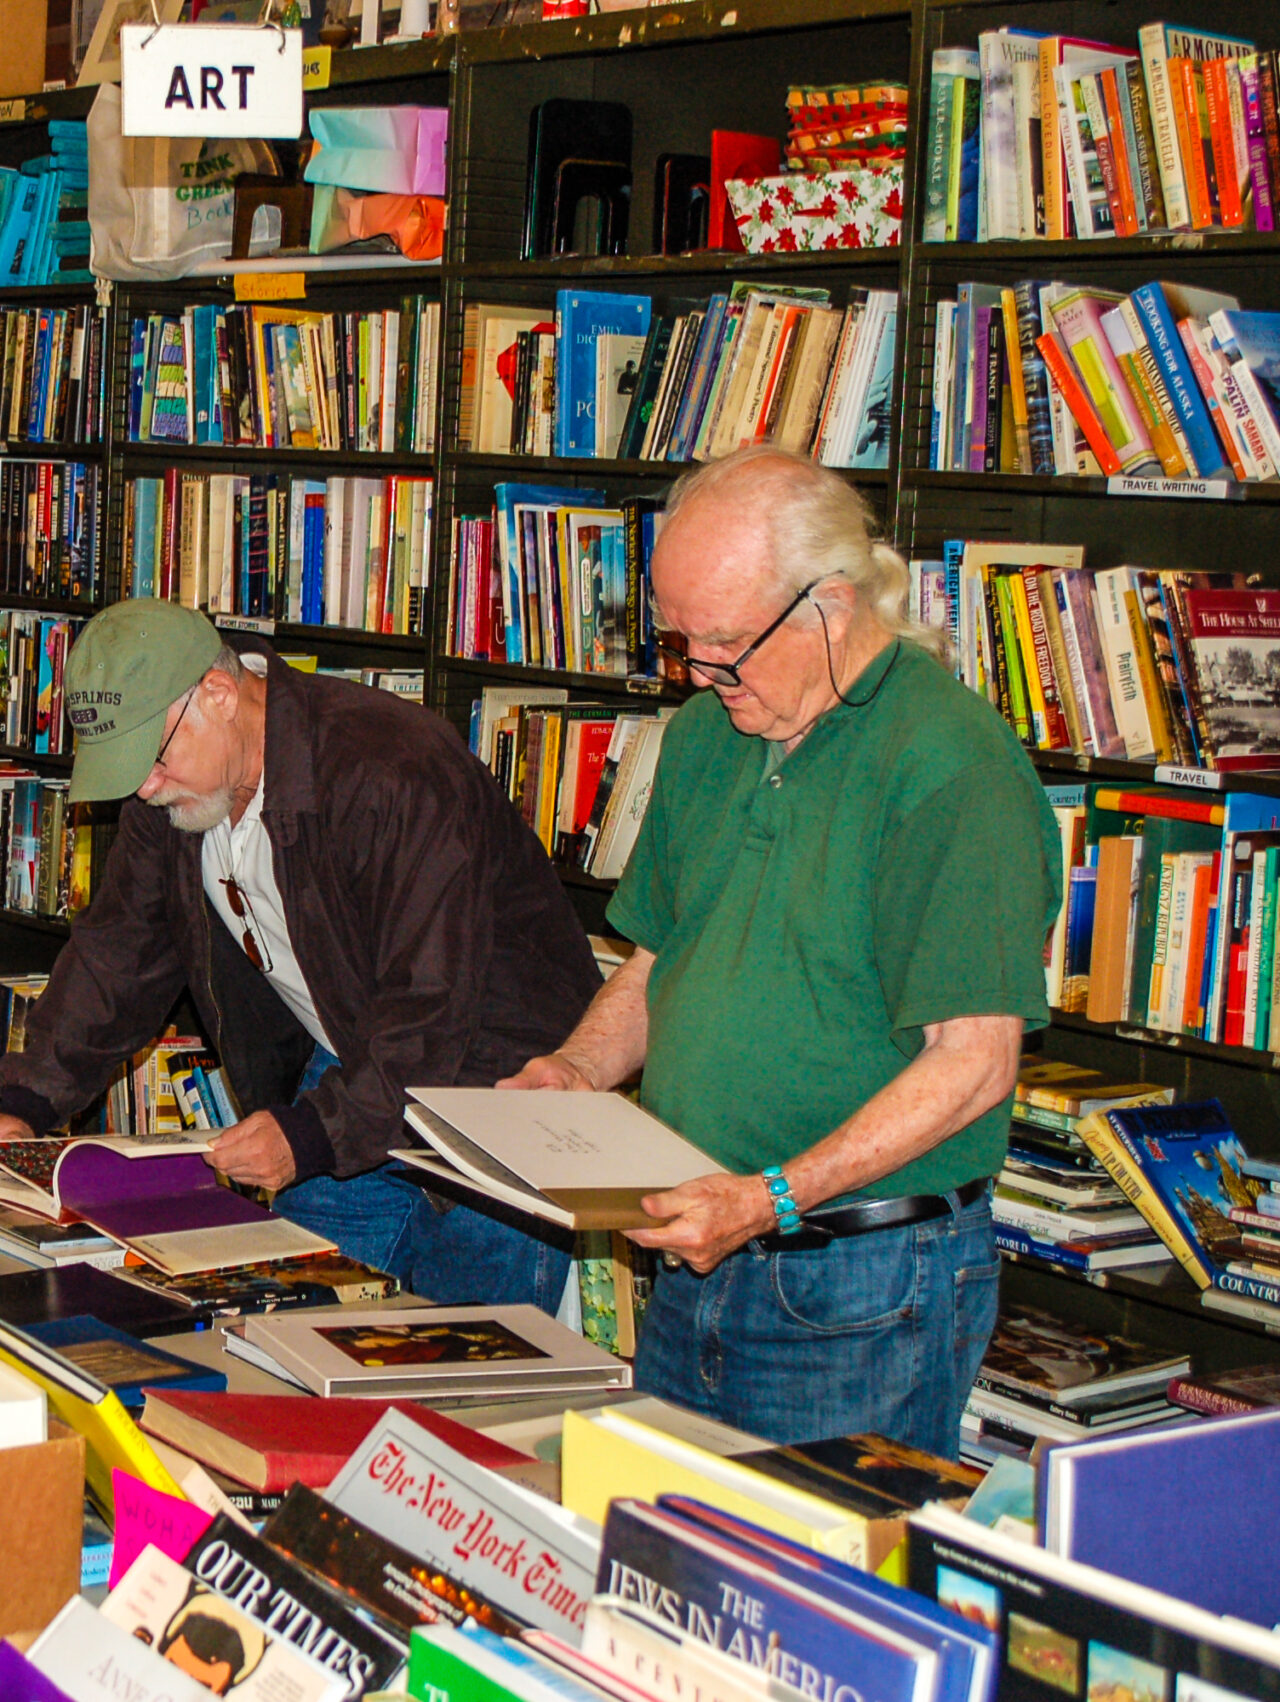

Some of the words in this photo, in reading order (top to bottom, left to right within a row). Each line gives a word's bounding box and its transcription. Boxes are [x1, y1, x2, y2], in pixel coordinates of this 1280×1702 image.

[1001, 42, 1039, 63] Writin
[165, 65, 255, 111] ART
[1130, 84, 1144, 133] African
[1158, 116, 1176, 171] TRAVELER
[241, 283, 289, 299] Stories
[1014, 284, 1032, 311] THE
[1140, 299, 1169, 350] LOOKING
[1163, 350, 1177, 374] FOR
[1171, 375, 1194, 421] ALASKA
[1223, 375, 1244, 420] PALIN
[1242, 419, 1267, 463] SAHARA
[1122, 479, 1159, 492] TRAVEL
[1162, 481, 1207, 494] WRITING
[626, 522, 638, 557] Norton
[626, 558, 638, 606] Anthology
[948, 548, 960, 602] AMERICAN
[220, 618, 237, 628] SHORT
[238, 621, 260, 631] STORIES
[625, 620, 638, 654] Poetry
[1031, 608, 1045, 633] ROAD
[1199, 612, 1219, 628] THE
[1220, 612, 1246, 628] HOUSE
[1036, 646, 1053, 688] FREEDOM
[70, 691, 123, 707] SPRINGS
[95, 720, 116, 735] PARK
[1169, 771, 1207, 786] TRAVEL
[1160, 866, 1174, 910] KYRGYZ
[1154, 912, 1169, 965] REPUBLIC
[1217, 1272, 1280, 1304] COUNTRY
[367, 1441, 411, 1498] The
[405, 1473, 466, 1534] New
[451, 1508, 529, 1583] York
[521, 1551, 590, 1632] Time
[195, 1537, 276, 1612] OUR
[259, 1587, 379, 1701] TIMES
[719, 1582, 767, 1633] THE
[608, 1559, 683, 1626] JEWS
[684, 1602, 724, 1652] IN
[724, 1627, 865, 1702] AMERIC
